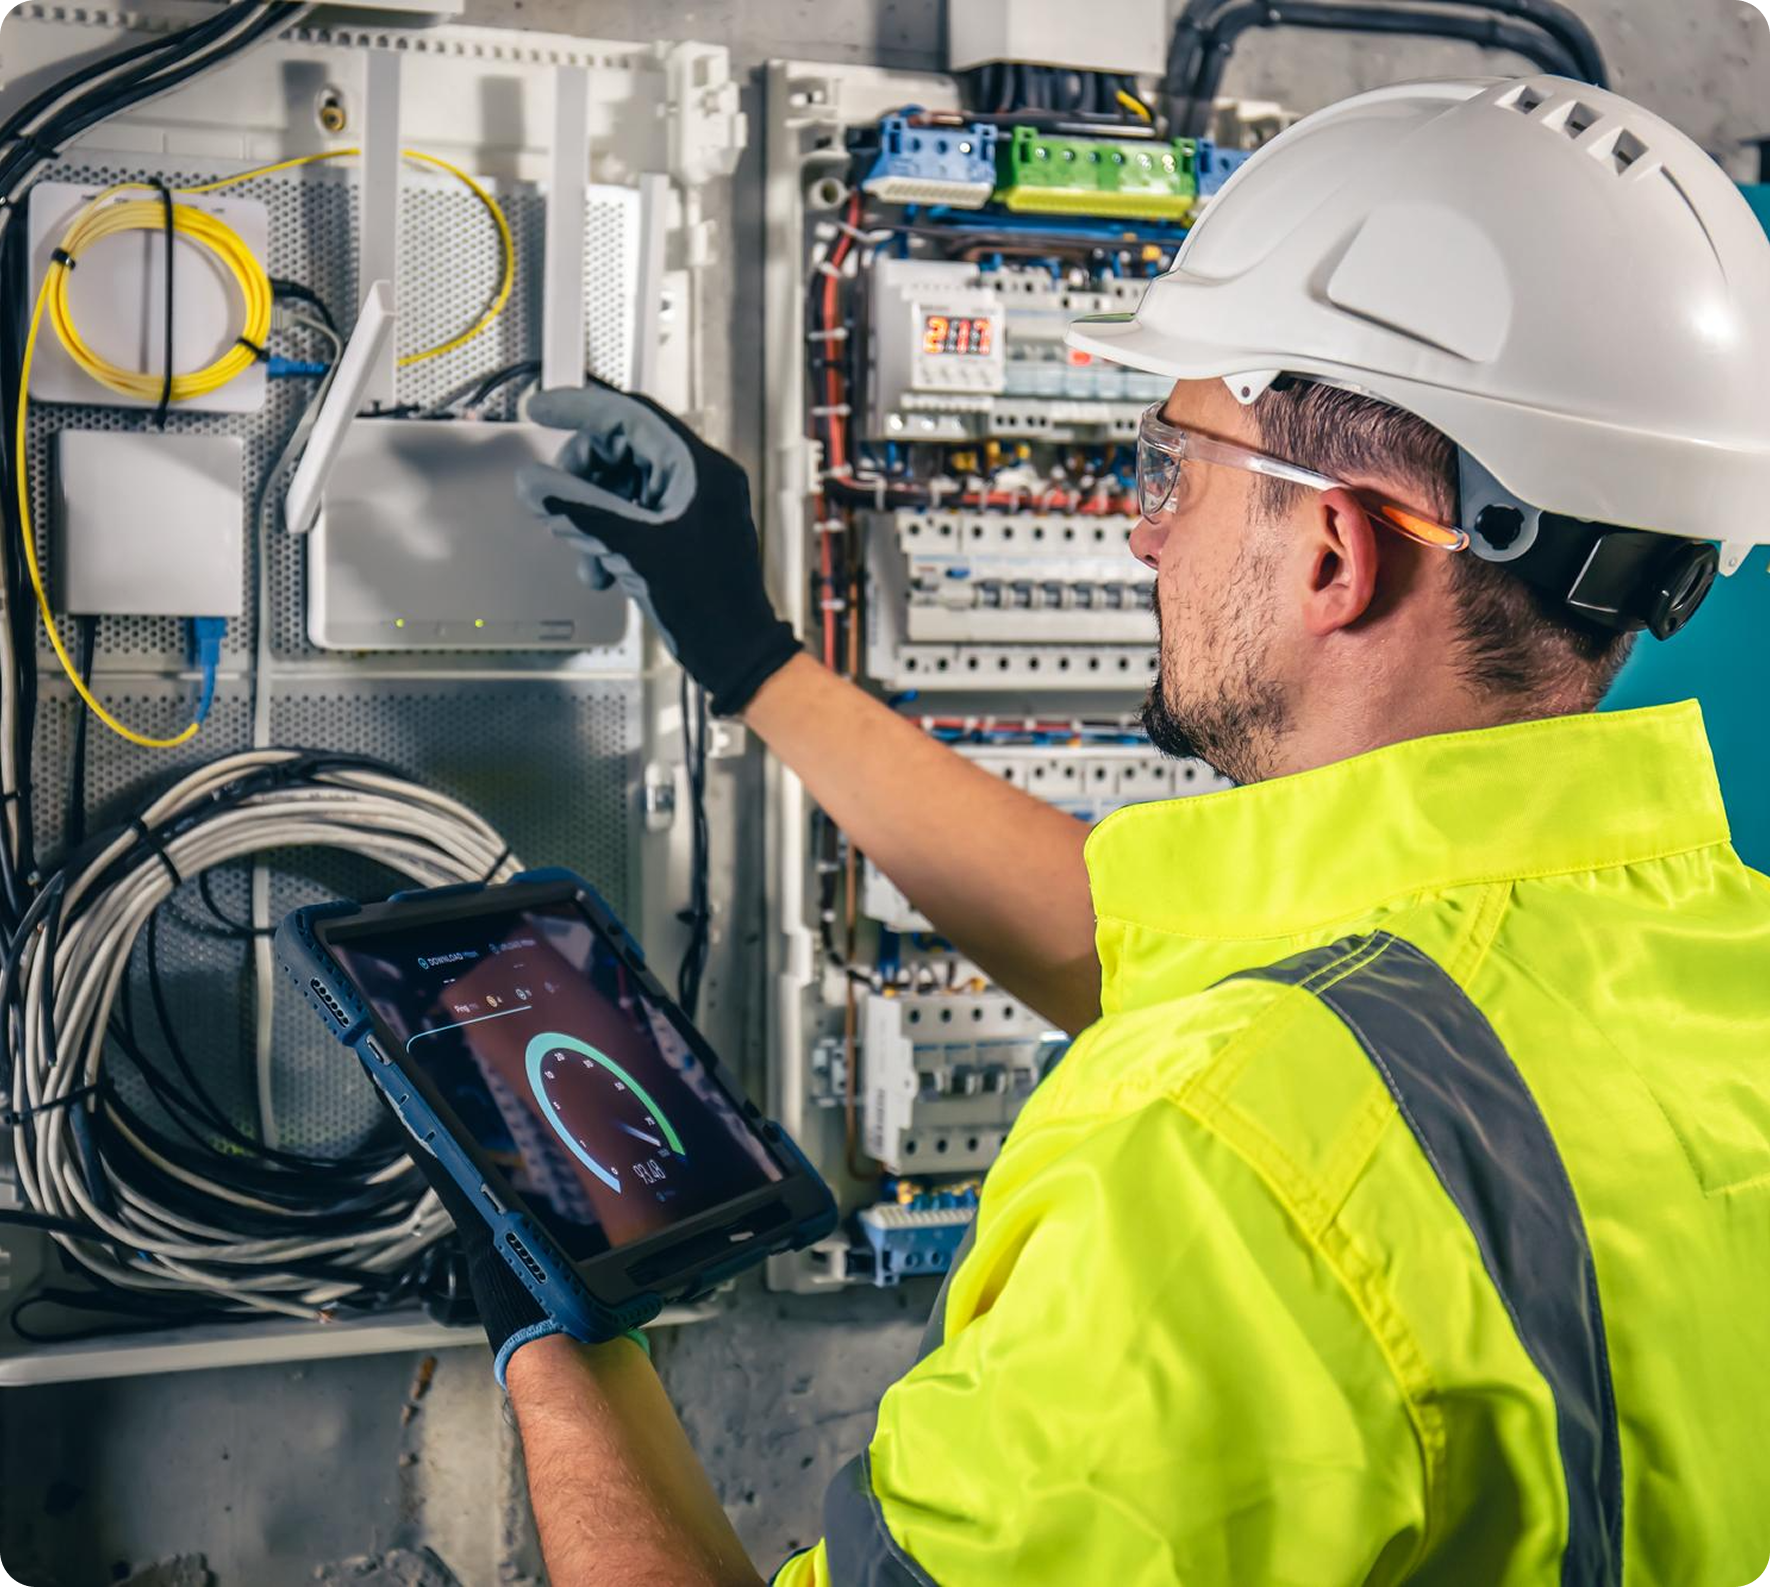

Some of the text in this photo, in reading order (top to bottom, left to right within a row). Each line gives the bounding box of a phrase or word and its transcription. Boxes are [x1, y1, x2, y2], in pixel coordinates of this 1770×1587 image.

[923, 315, 990, 354] 217
[427, 952, 464, 966] DOWNLOAD
[454, 1004, 471, 1013] Ping
[611, 1167, 619, 1175] 0
[633, 1159, 666, 1184] 93.48
